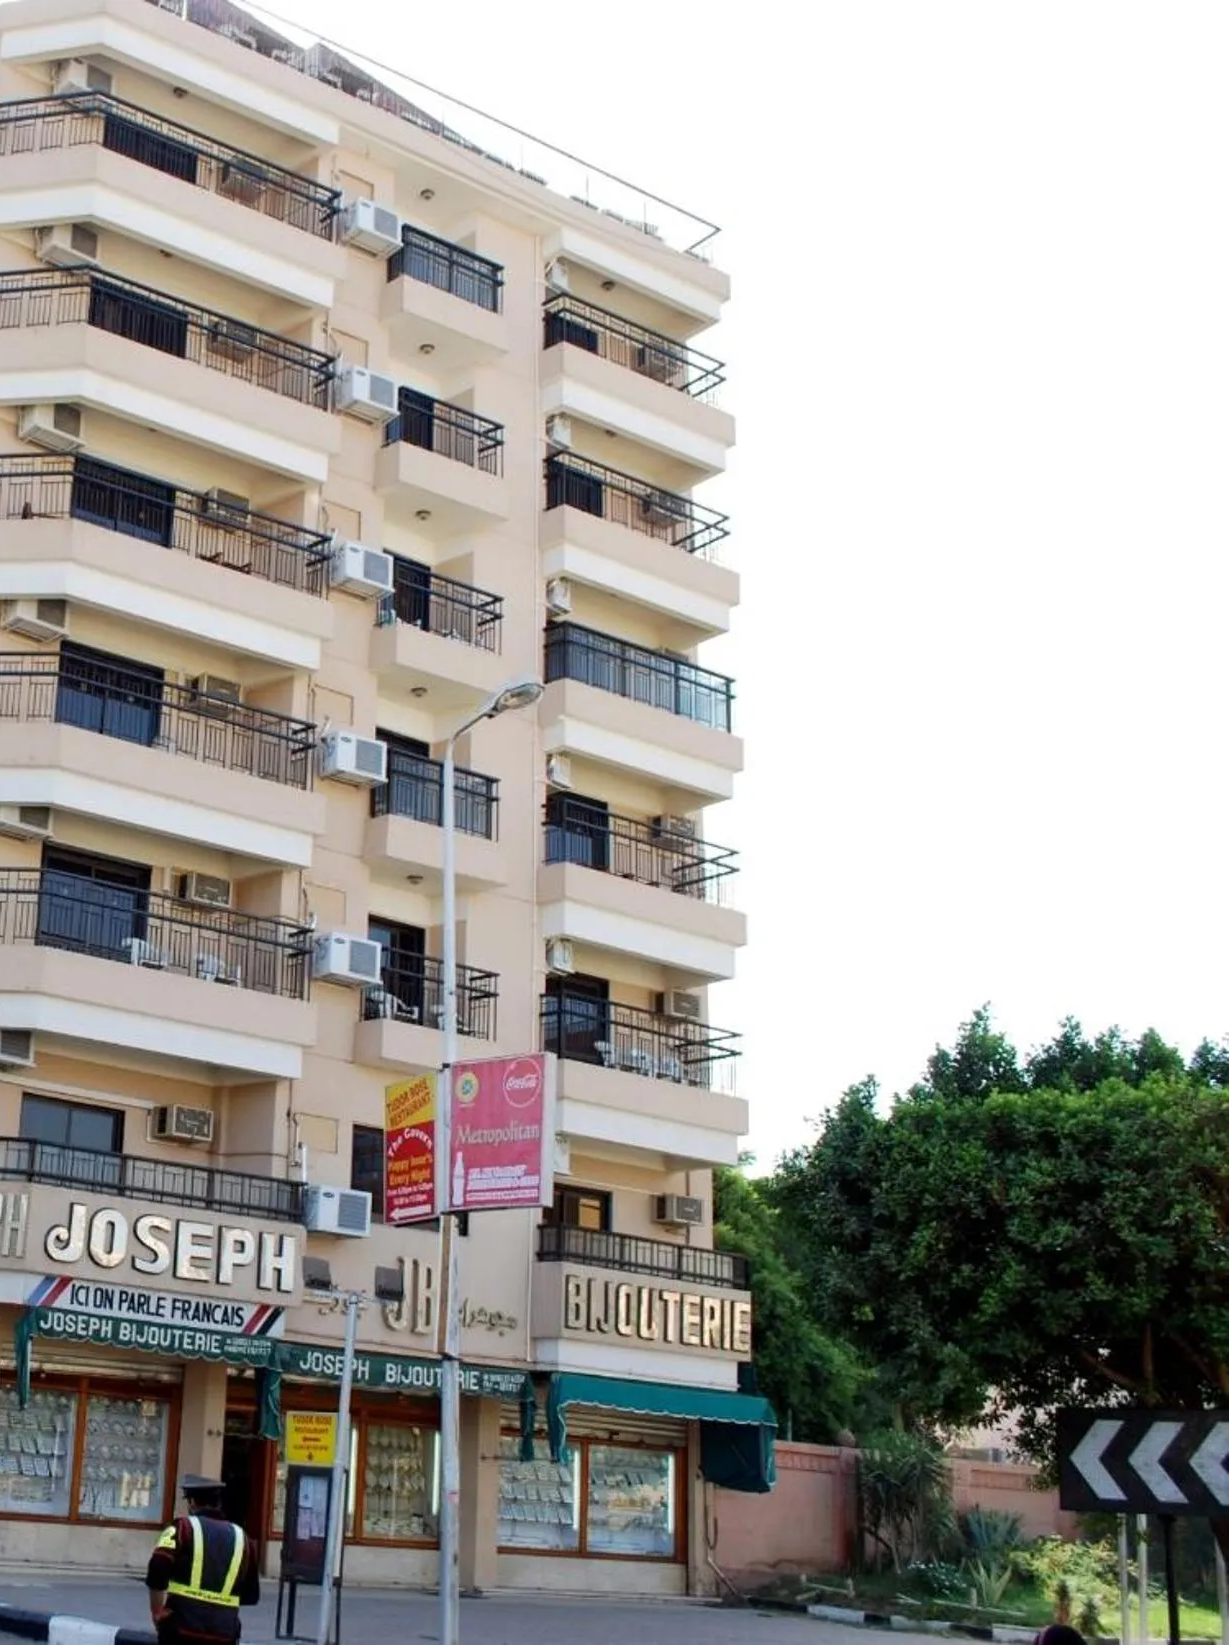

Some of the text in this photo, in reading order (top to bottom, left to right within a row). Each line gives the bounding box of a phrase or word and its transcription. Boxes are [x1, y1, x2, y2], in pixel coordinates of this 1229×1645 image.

[456, 1120, 540, 1148] Metropolitan
[44, 1201, 297, 1293] JOSEPH
[71, 1284, 90, 1309] ICI
[93, 1285, 115, 1311] ON
[117, 1289, 166, 1318] PARLE
[564, 1274, 752, 1353] BIJOUTERIE
[39, 1310, 221, 1354] JOSEPH BIJOUTERIE
[385, 1363, 480, 1390] BIJOUTRIE
